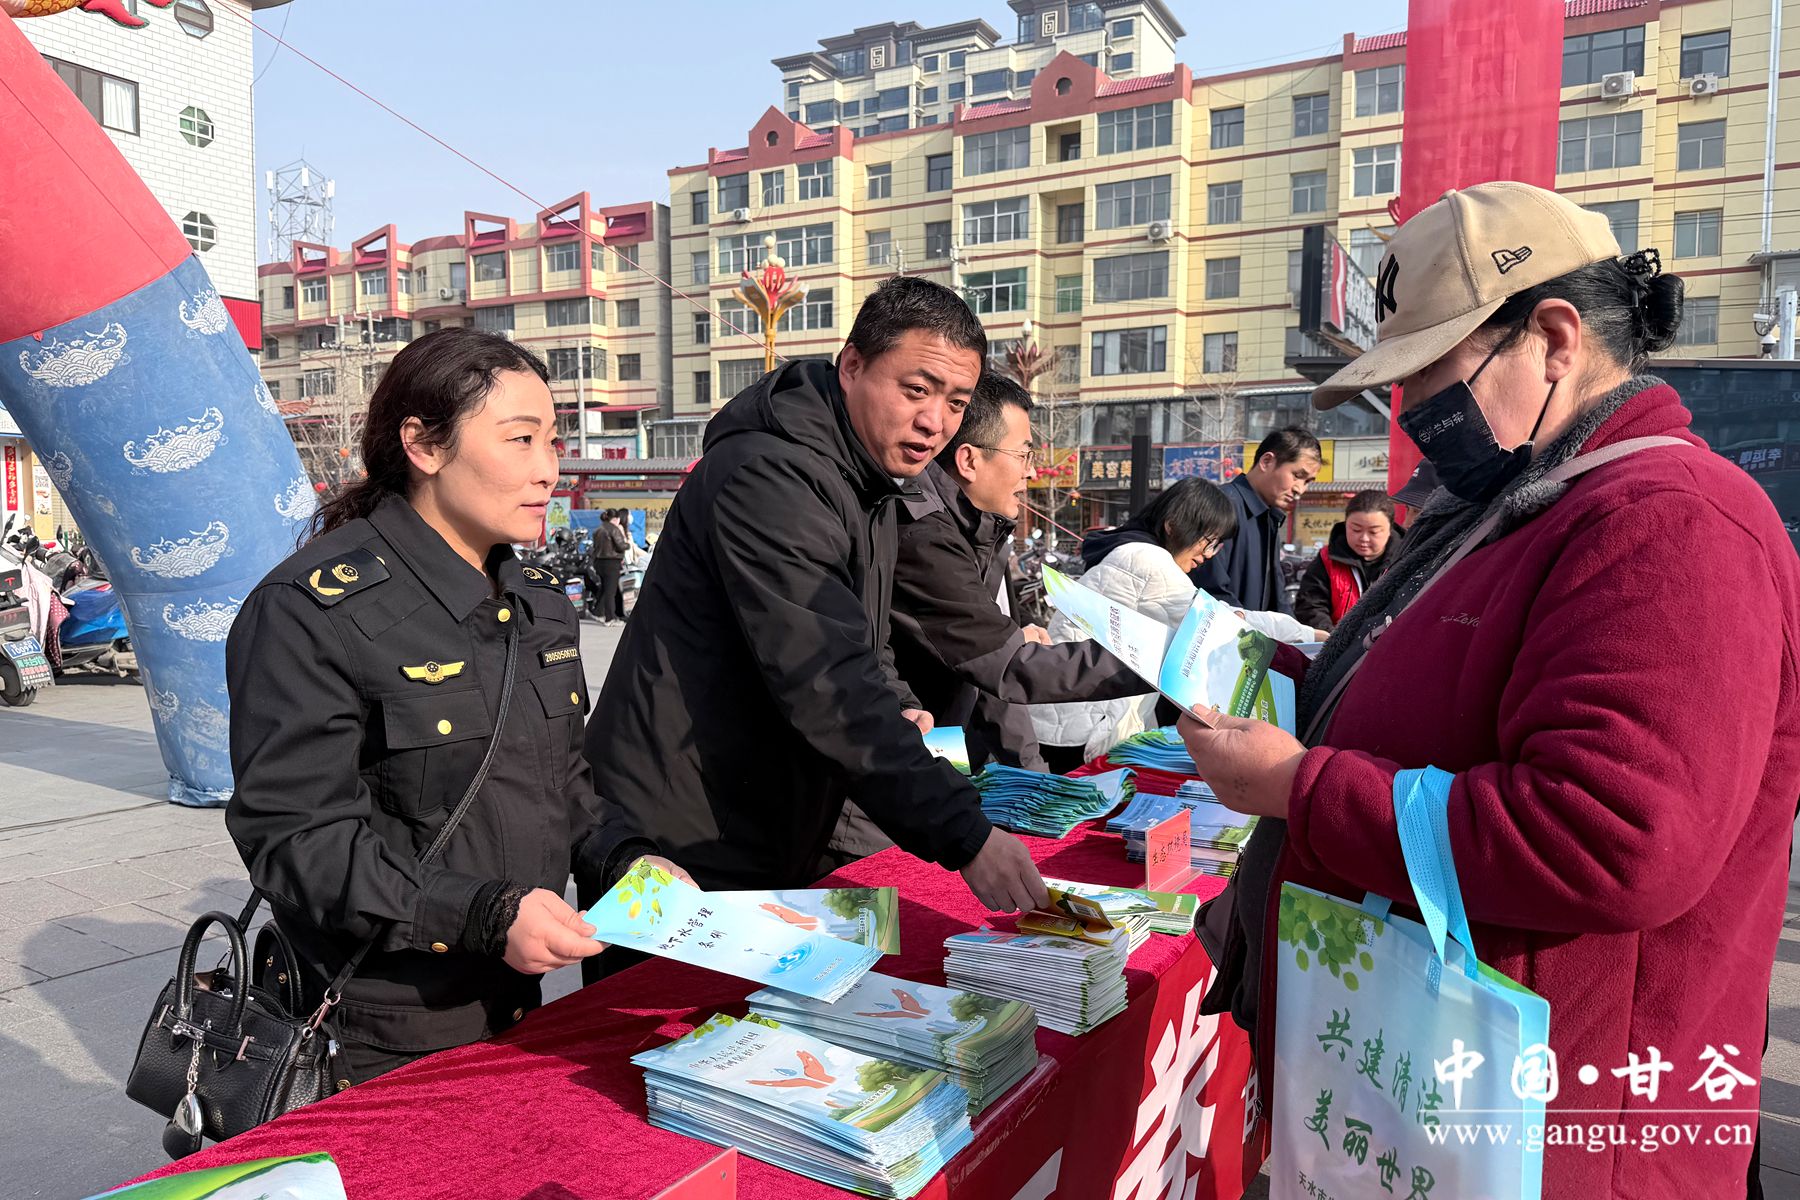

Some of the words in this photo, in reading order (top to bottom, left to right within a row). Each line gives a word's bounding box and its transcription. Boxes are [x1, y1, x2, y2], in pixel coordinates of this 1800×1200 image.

[657, 906, 714, 951] 地下水管理
[697, 929, 729, 949] 条例
[688, 1030, 760, 1069] 中华人民共和国
[1316, 1007, 1444, 1135] 共建清洁
[1303, 1087, 1436, 1200] 美丽世界
